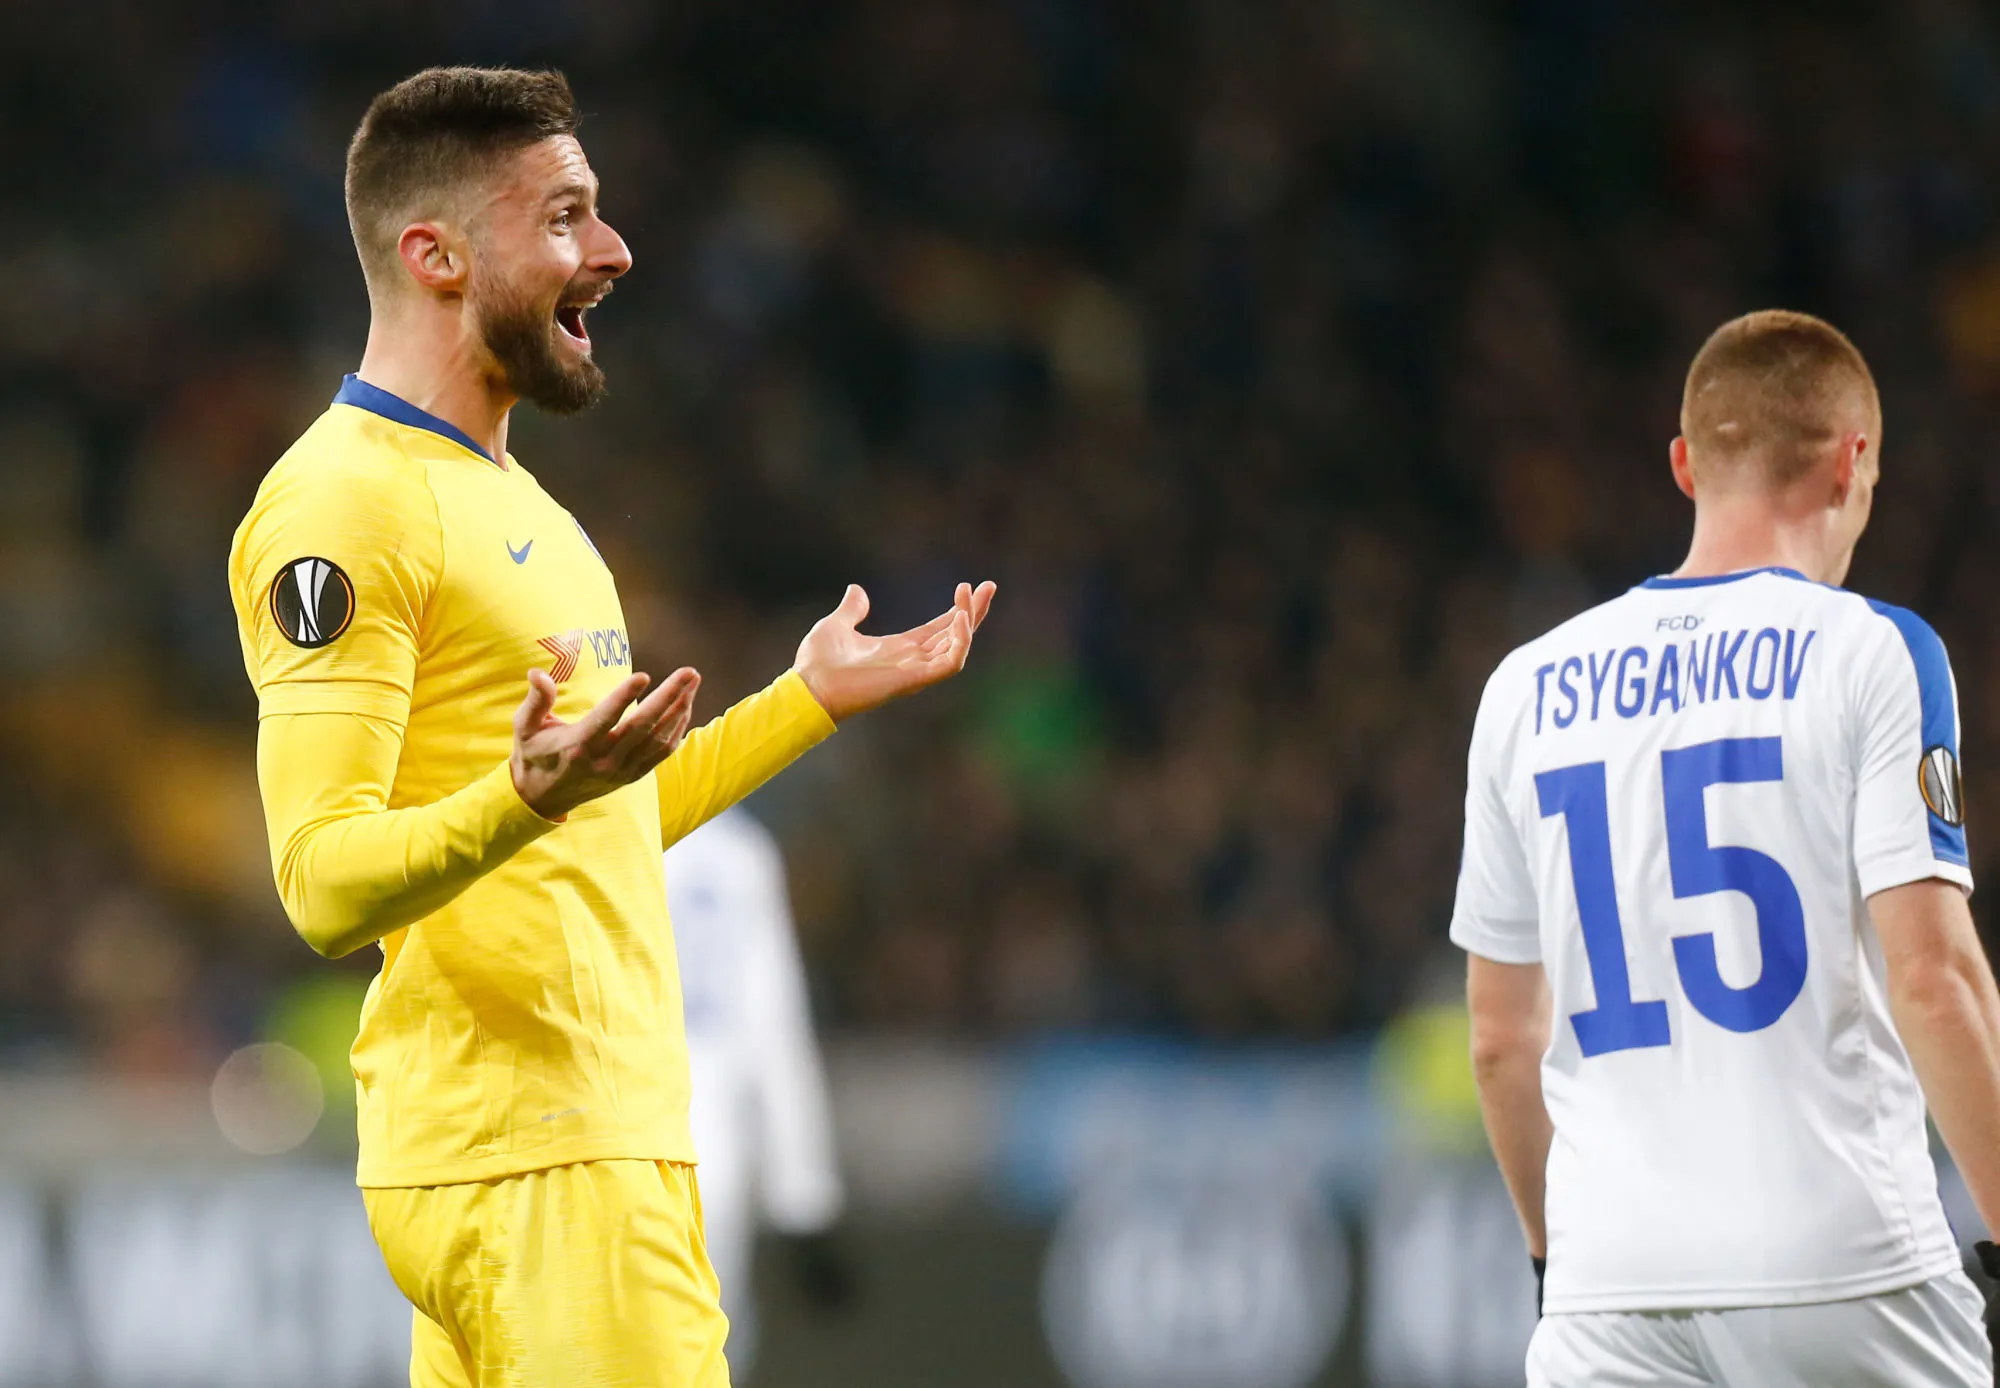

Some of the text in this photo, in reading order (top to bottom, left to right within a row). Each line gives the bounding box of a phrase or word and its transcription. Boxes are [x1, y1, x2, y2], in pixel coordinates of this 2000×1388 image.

[1655, 614, 1704, 632] FCD
[1533, 626, 1816, 736] TSYGANKOV
[1533, 735, 1808, 1059] 15
